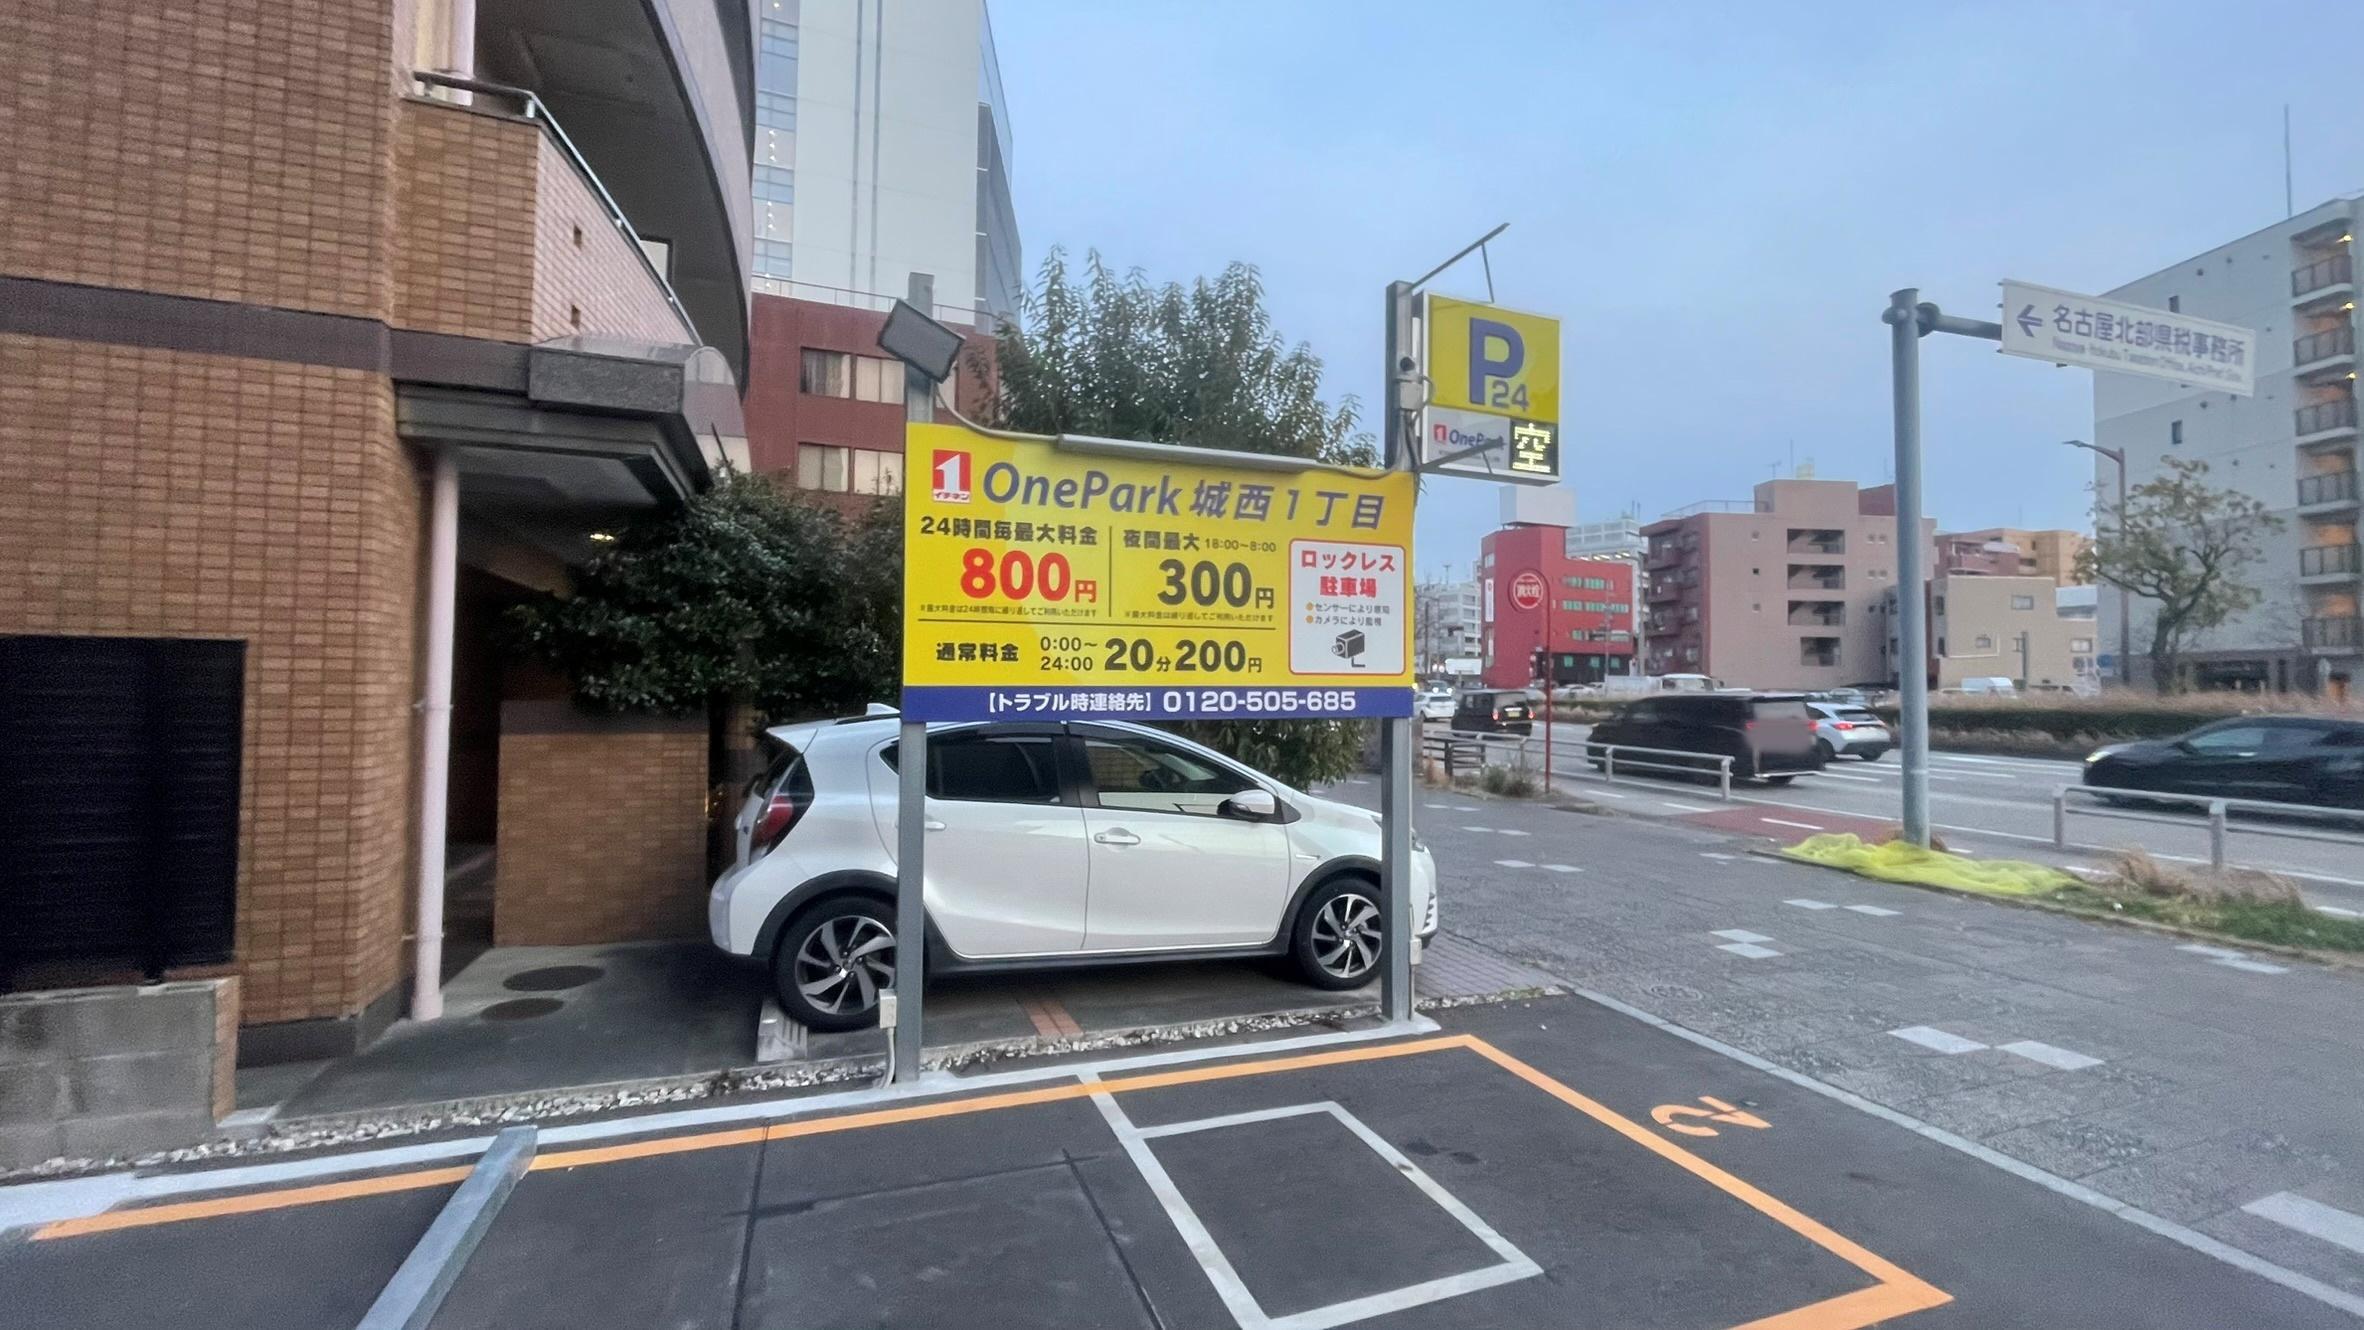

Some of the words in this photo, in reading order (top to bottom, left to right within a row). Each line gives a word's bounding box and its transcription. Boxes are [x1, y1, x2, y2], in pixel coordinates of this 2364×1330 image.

[1469, 317, 1525, 405] P
[1491, 380, 1530, 411] 24
[1513, 423, 1551, 473] 空
[983, 462, 1183, 515] OnePark
[1190, 480, 1385, 530] 城西1丁目
[920, 516, 1098, 546] 24時間毎最大料金
[1123, 529, 1200, 551] 夜間最大
[960, 547, 1097, 603] 800円
[1301, 550, 1395, 572] ロックレス
[1157, 558, 1274, 609] 300円
[1320, 576, 1377, 598] 駐車場
[936, 643, 1019, 662] 通常料金
[1040, 656, 1093, 671] 24:00
[1163, 691, 1356, 713] 0120-505-685
